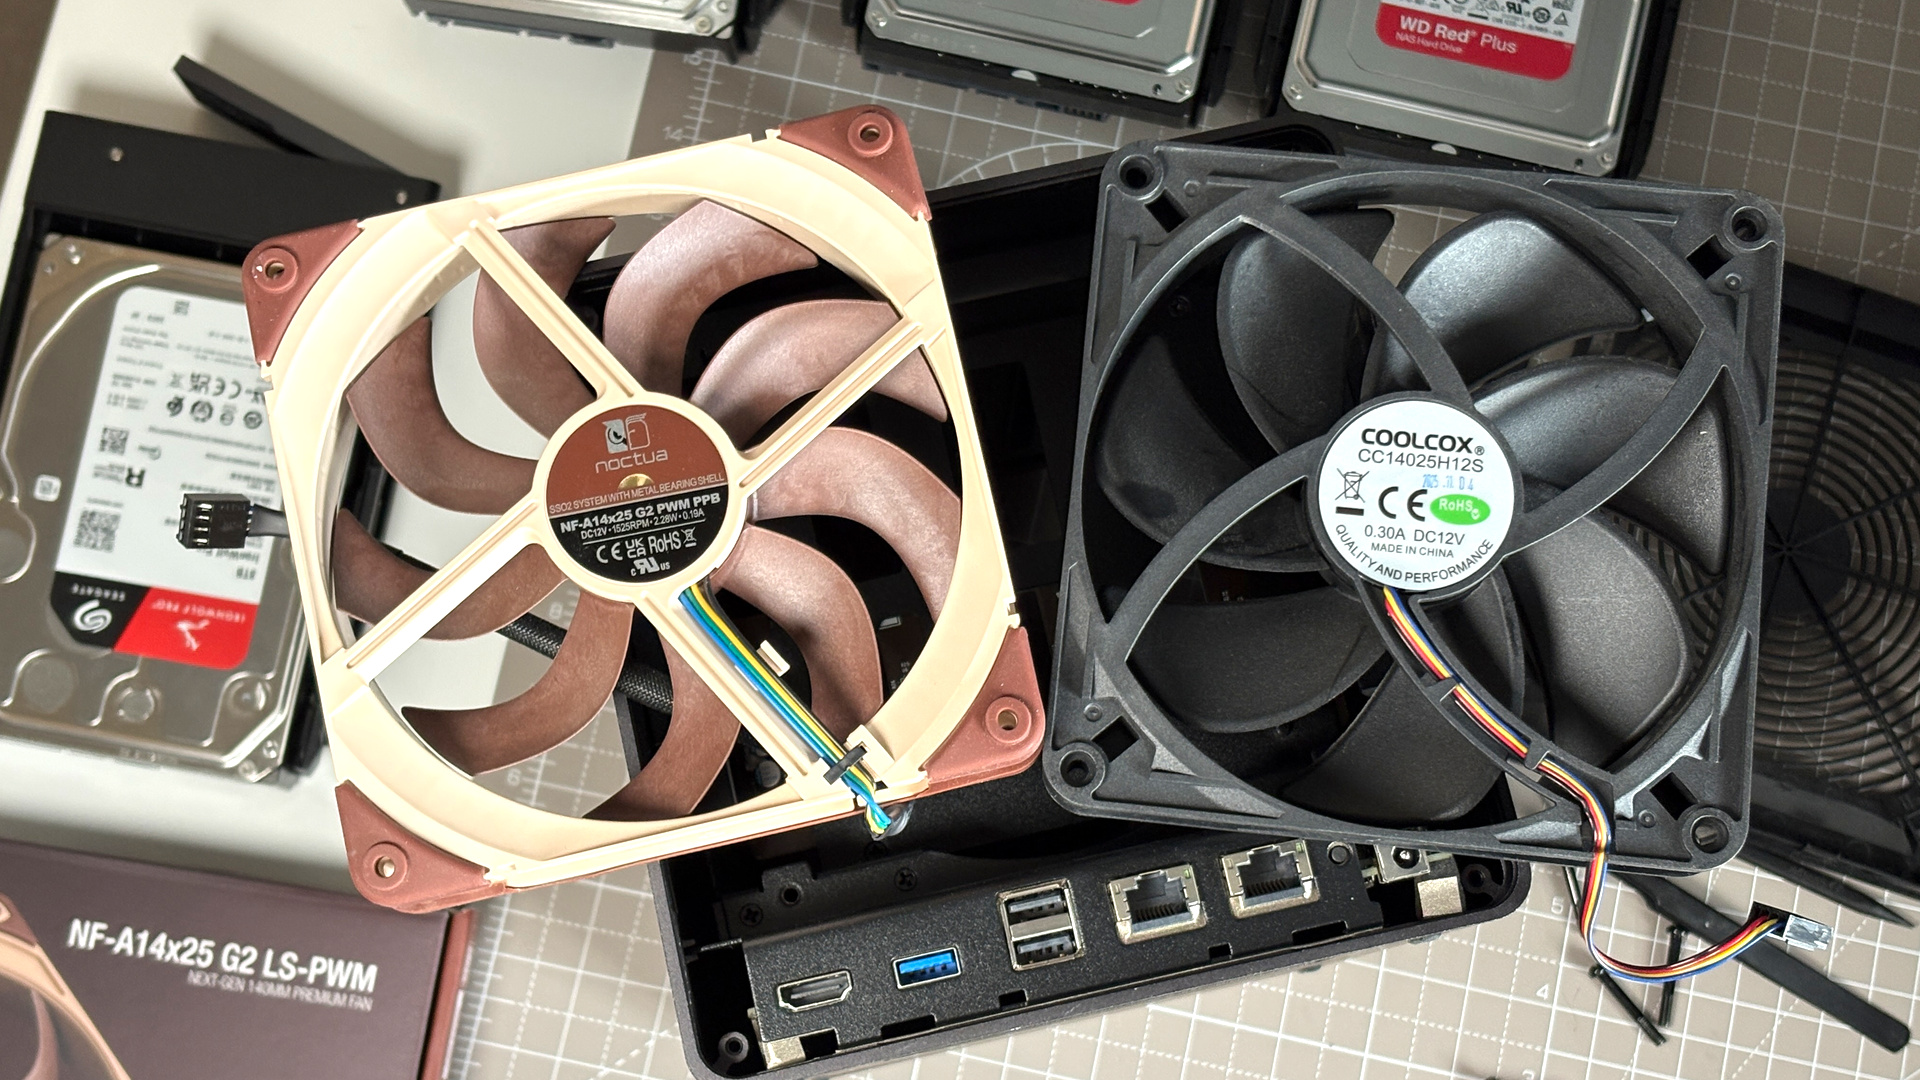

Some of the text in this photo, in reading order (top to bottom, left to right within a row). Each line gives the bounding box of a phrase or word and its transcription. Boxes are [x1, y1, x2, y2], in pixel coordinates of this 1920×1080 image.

[1395, 32, 1463, 54] NAS Hard Drive
[1400, 14, 1431, 35] WD
[1480, 33, 1517, 54] Plus
[663, 126, 683, 142] 14
[595, 449, 668, 474] noctua
[1358, 448, 1484, 473] CC14025H12S
[549, 473, 724, 514] SSO2 SYSTEM WITH METAL BEARING SHELL
[1438, 497, 1473, 512] RoHS
[560, 492, 721, 533] NF-A14x25 G2 PWM PPB
[647, 531, 682, 555] RoHS
[1364, 524, 1466, 546] 0.30A DC12V
[1335, 524, 1494, 584] QUALITY AND PERFORMANCE
[1370, 542, 1455, 558] MADE IN CHINA
[71, 583, 126, 602] SEAGATE
[182, 602, 246, 623] IRONWOLF
[507, 768, 521, 787] 6
[1551, 897, 1565, 915] 5
[66, 917, 379, 993] NF-A14x25 G2 LS-PWM
[348, 993, 374, 1012] FAN
[1536, 984, 1550, 1001] 4
